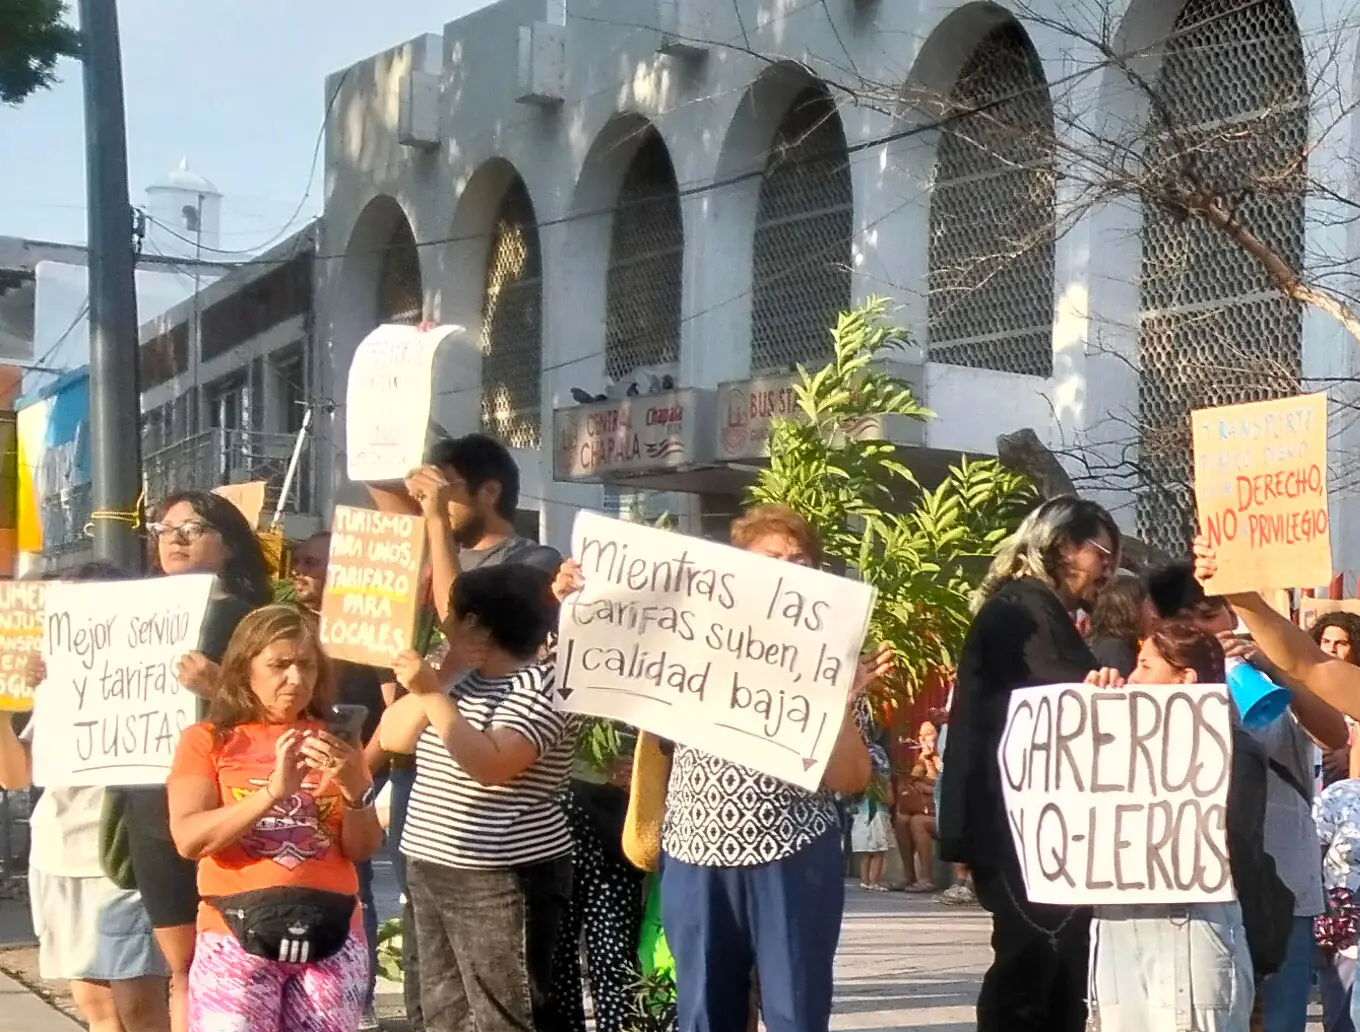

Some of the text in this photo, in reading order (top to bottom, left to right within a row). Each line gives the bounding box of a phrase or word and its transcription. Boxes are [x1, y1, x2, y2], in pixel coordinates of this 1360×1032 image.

[587, 409, 632, 437] CENTRAL
[749, 390, 775, 419] BUS
[580, 433, 641, 469] CHAPALA
[1236, 464, 1324, 512] DERECHO,
[329, 531, 363, 559] PARA
[335, 507, 413, 539] TURISMO
[1207, 508, 1327, 549] NO PRIVILEGIO
[328, 563, 410, 596] TARIFAZO
[343, 592, 392, 619] PARA
[767, 576, 829, 632] las
[49, 605, 190, 669] Mejor servicio
[320, 615, 406, 657] LOCALES
[568, 590, 842, 687] tarifas suben, la
[100, 655, 180, 701] tarifas
[582, 641, 811, 737] calidad baja
[73, 709, 186, 761] JUSTAS
[1002, 688, 1232, 798] CAREROS
[1010, 798, 1231, 894] Y Q-LEROS
